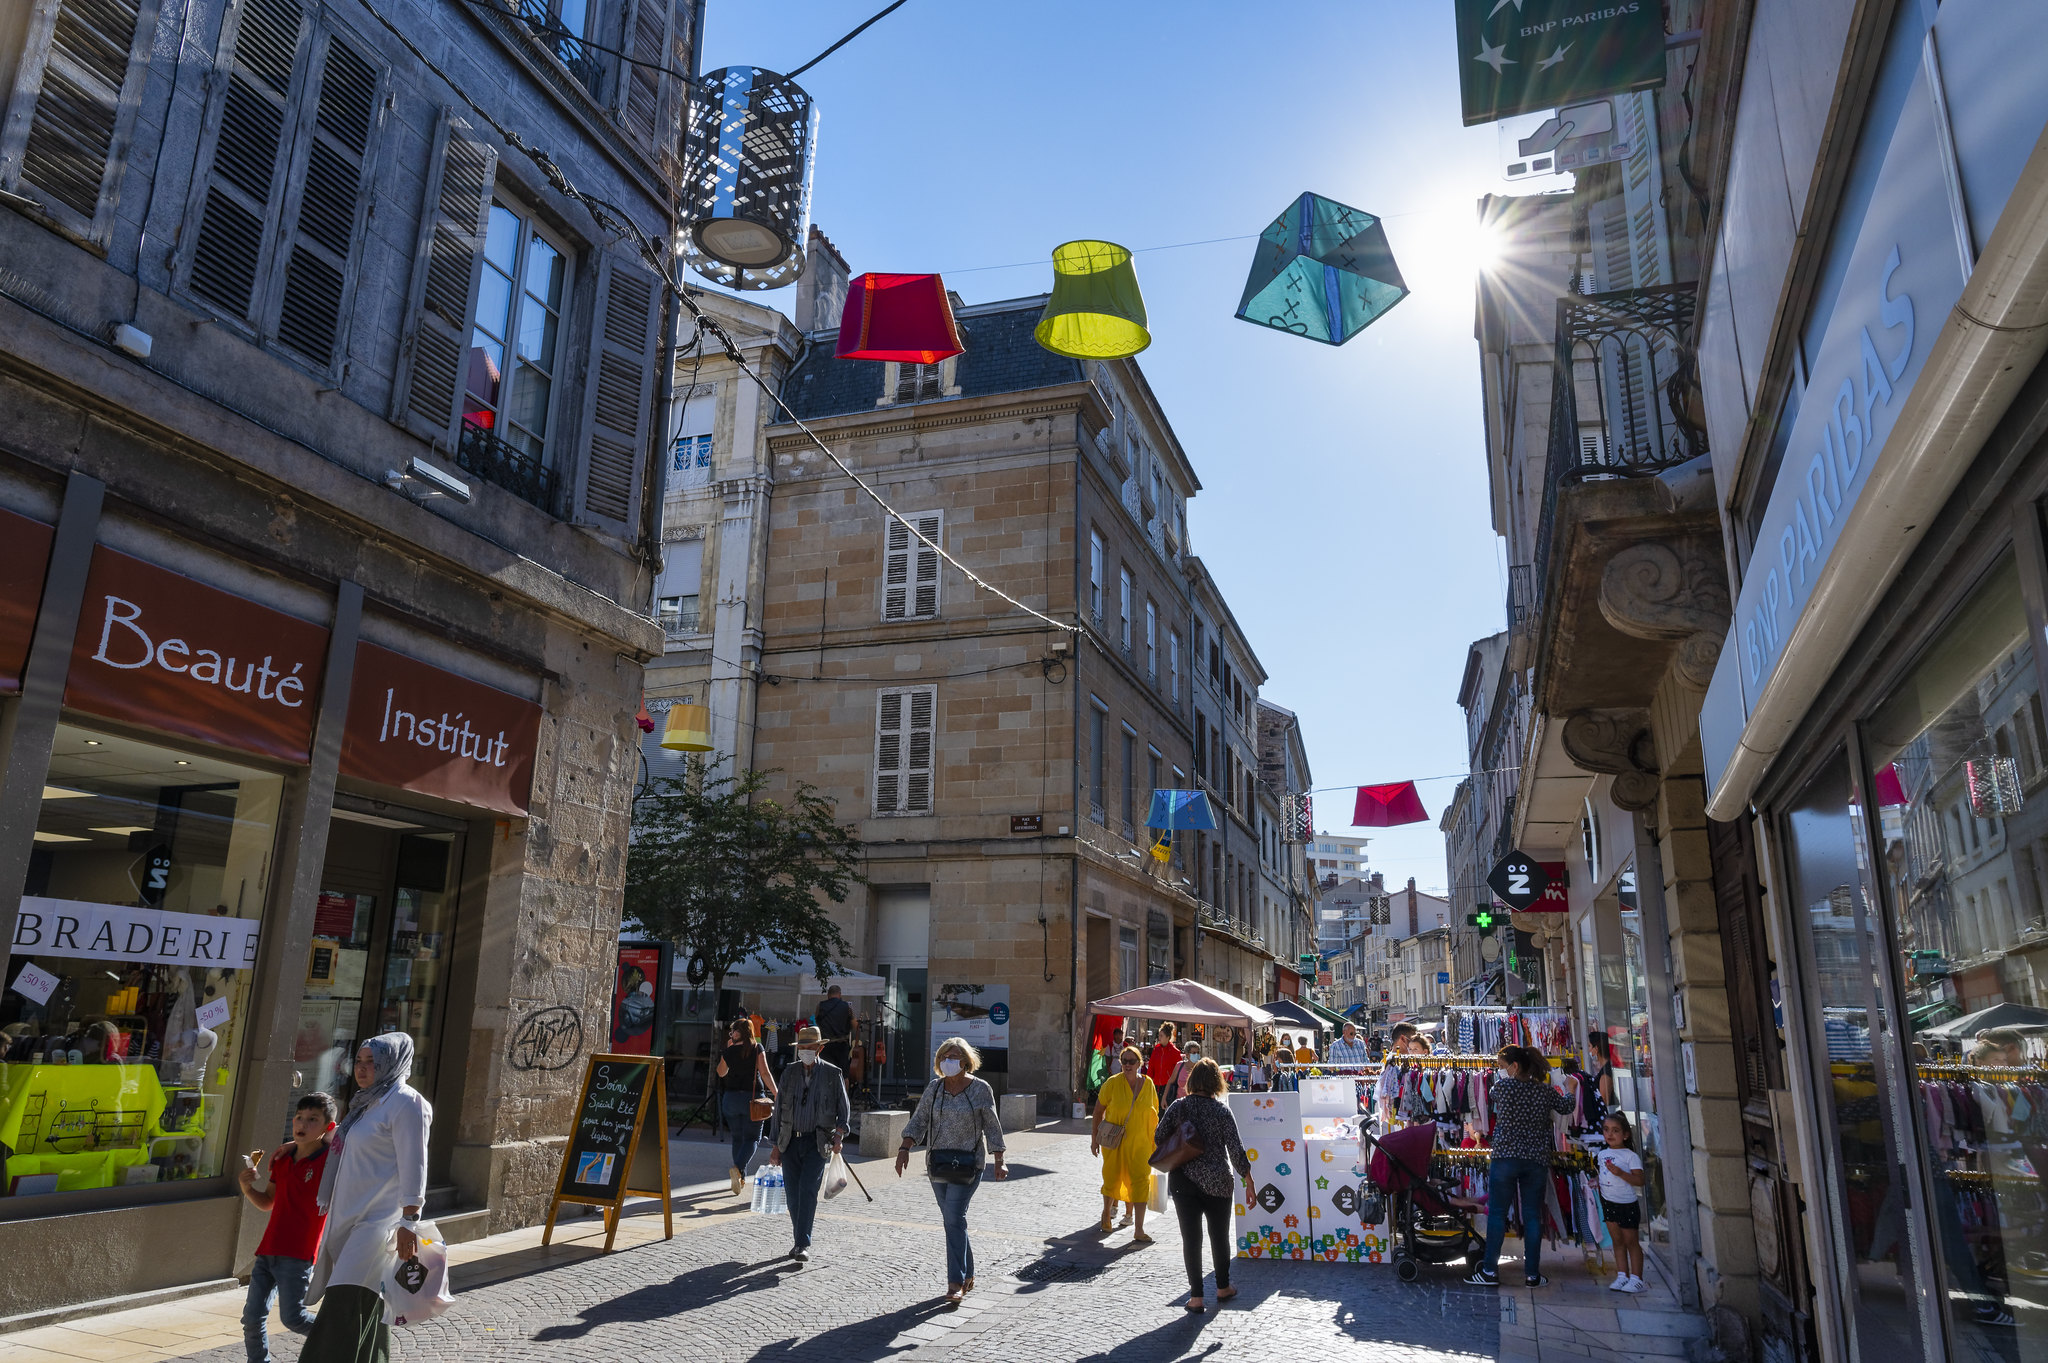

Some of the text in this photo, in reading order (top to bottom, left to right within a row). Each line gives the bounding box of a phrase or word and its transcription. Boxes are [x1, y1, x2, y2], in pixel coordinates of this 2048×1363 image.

[1520, 2, 1640, 37] BNP PARIBAS
[1745, 242, 1915, 687] BNP PARIBAS
[91, 595, 304, 707] Beauté
[379, 688, 510, 768] Institut
[12, 912, 258, 962] BRADERIE
[22, 973, 50, 993] -50 %
[199, 1005, 224, 1023] -50 %
